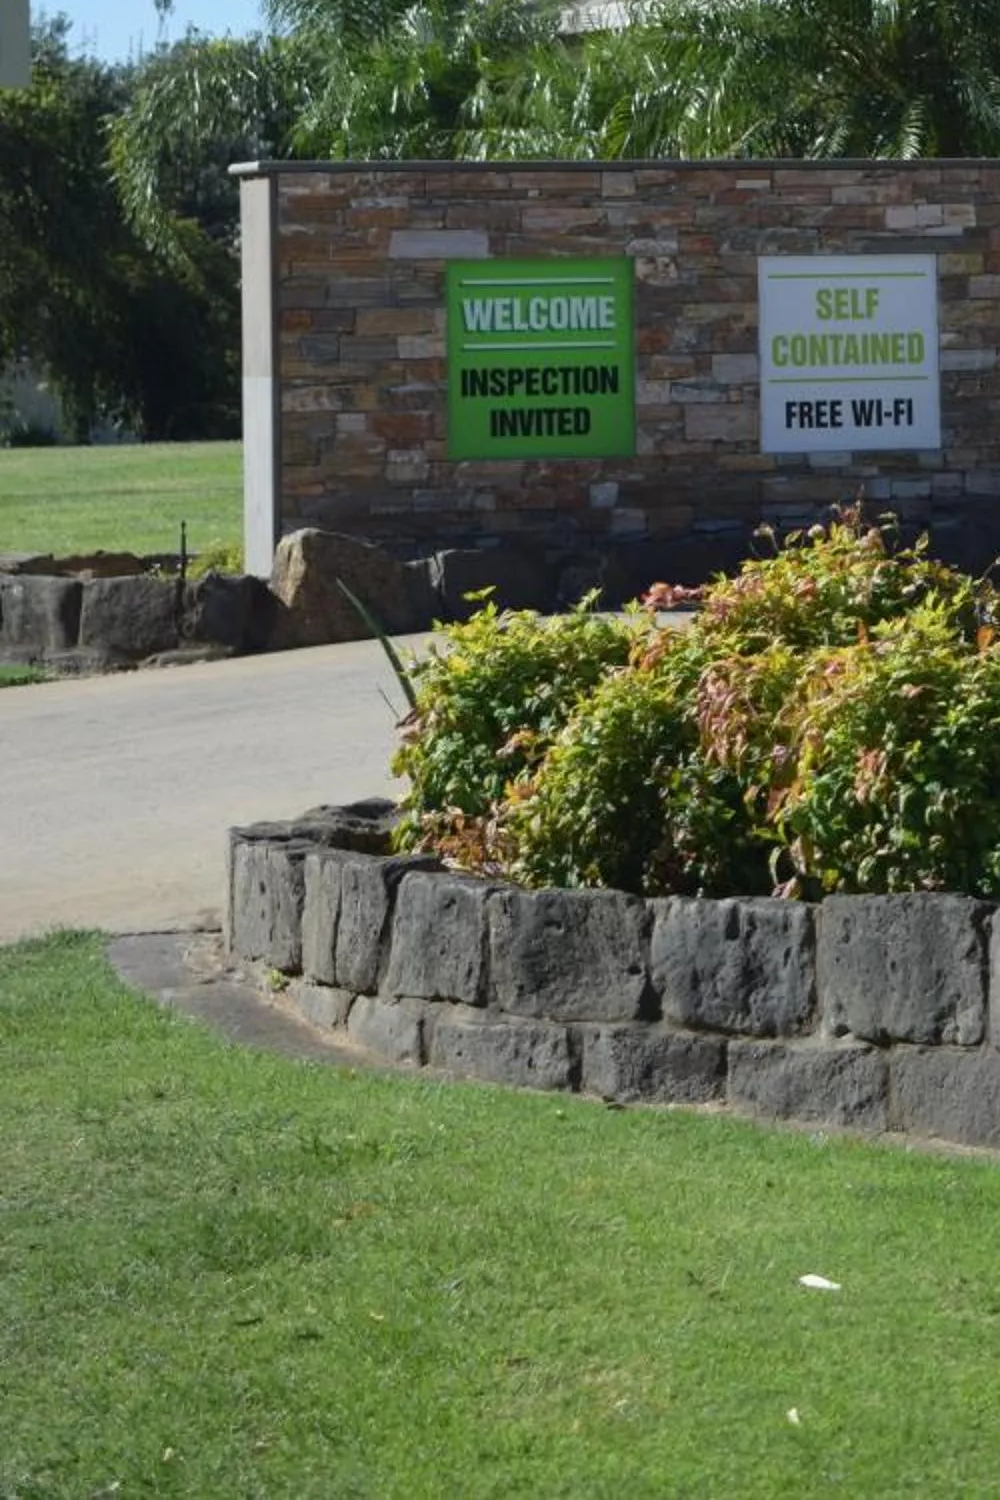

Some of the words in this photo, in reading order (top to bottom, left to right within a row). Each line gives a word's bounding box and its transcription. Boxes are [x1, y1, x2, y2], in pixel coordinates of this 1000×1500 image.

[462, 296, 616, 332] WELCOME
[815, 288, 880, 320] SELF
[771, 332, 925, 367] CONTAINED
[460, 365, 619, 398] INSPECTION
[490, 406, 590, 437] INVITED
[785, 400, 843, 429] FREE
[852, 398, 914, 427] WI-FI
